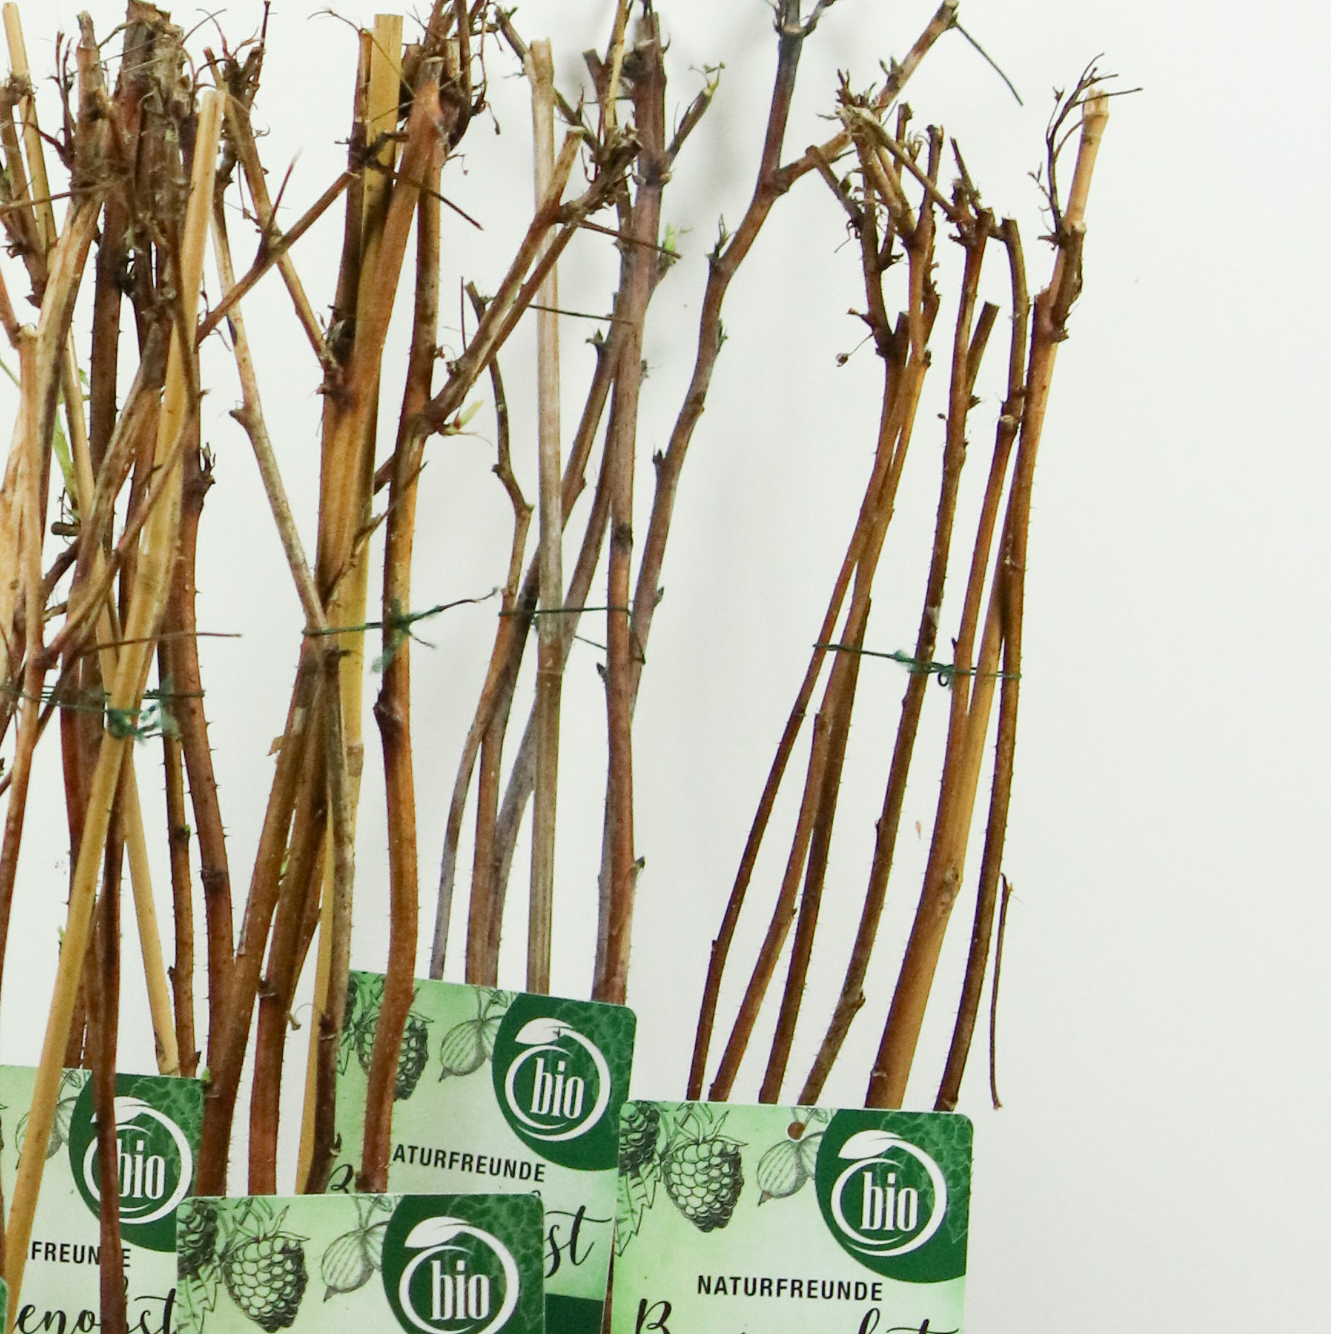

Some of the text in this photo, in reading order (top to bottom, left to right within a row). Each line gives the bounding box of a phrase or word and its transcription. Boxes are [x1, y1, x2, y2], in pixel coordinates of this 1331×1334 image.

[530, 1057, 585, 1120] bio
[116, 1138, 166, 1200] bio
[391, 1143, 546, 1183] ATURFREUNDE
[860, 1171, 919, 1232] bio
[430, 1260, 491, 1320] bio
[697, 1275, 883, 1302] NATURFREUNDE
